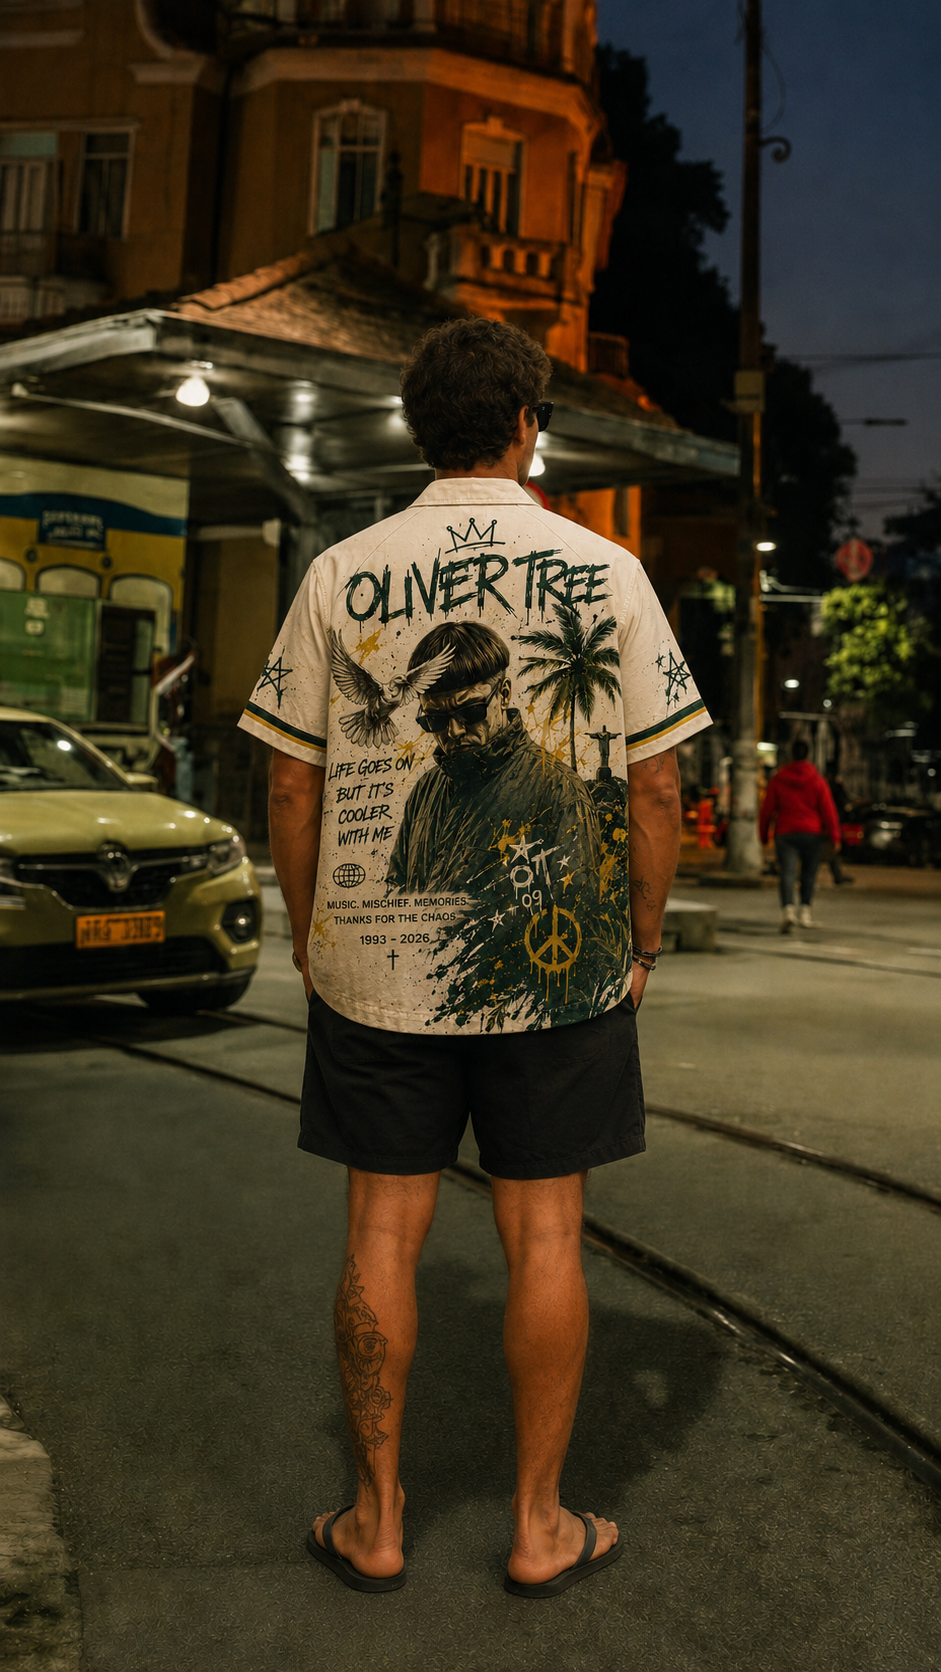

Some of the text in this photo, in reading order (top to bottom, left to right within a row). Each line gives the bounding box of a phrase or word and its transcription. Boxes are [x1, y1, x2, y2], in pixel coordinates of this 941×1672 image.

[345, 549, 612, 625] OLIVER TREE
[328, 753, 415, 781] LIFE GOES ON
[336, 785, 366, 803] BUT
[338, 804, 393, 824] COOLER
[338, 826, 395, 846] WITH ME
[327, 900, 359, 910] MUSIC.
[362, 899, 412, 909] MISCHIEF.
[334, 912, 456, 925] THANKS FOR THE CHAOS
[359, 935, 387, 946] 1993
[400, 933, 430, 944] 2026
